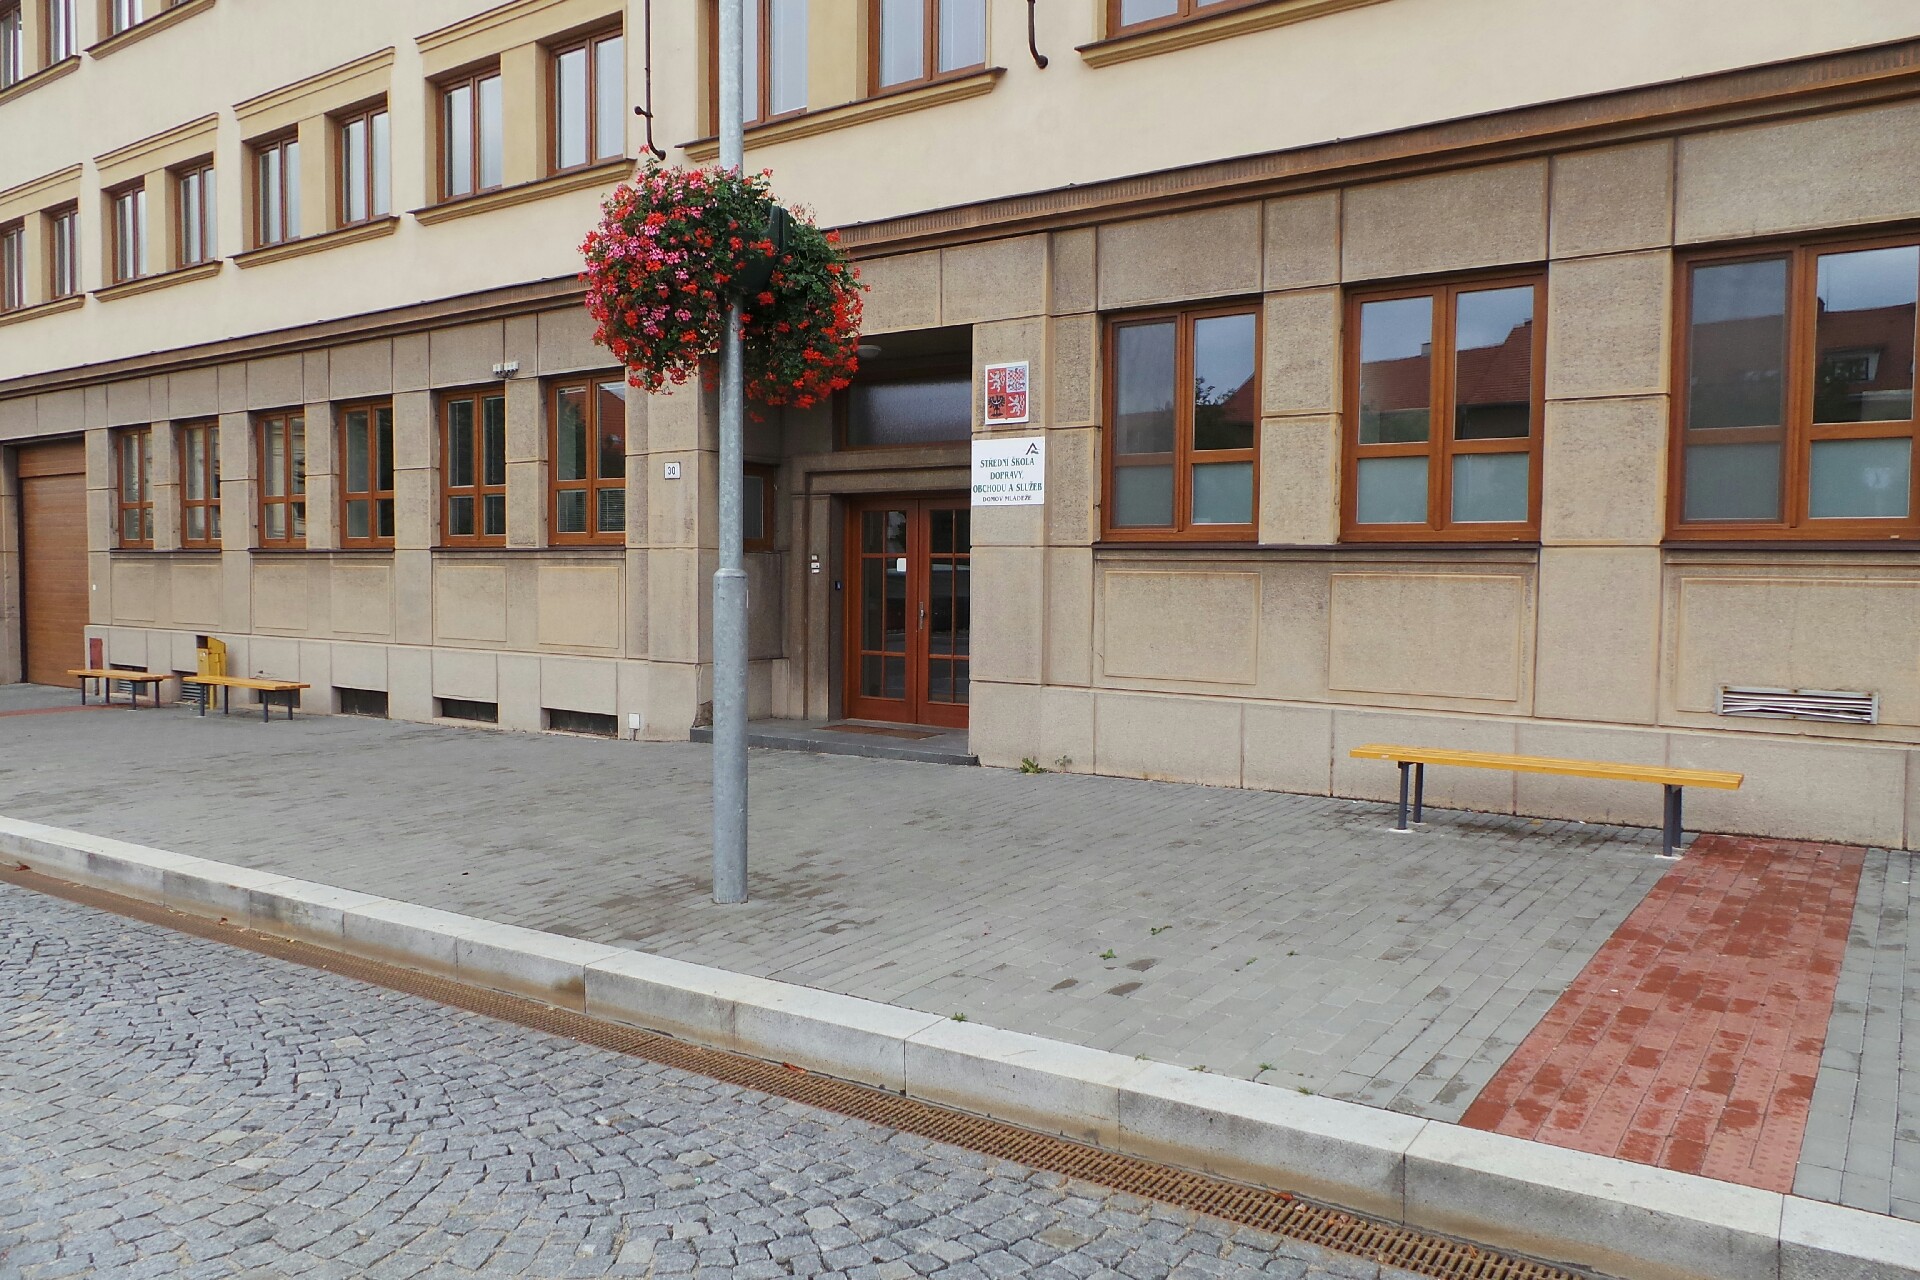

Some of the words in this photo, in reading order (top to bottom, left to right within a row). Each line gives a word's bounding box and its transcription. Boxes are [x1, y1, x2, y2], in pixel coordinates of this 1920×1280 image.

[980, 457, 1009, 468] STŘEDNÍ
[1011, 456, 1035, 467] ŠKOLA
[667, 466, 676, 475] 30
[990, 470, 1024, 480] DOPRAVY,
[972, 484, 1006, 493] OBCHODU
[1008, 483, 1014, 492] A
[1016, 481, 1043, 492] SLUŽEB
